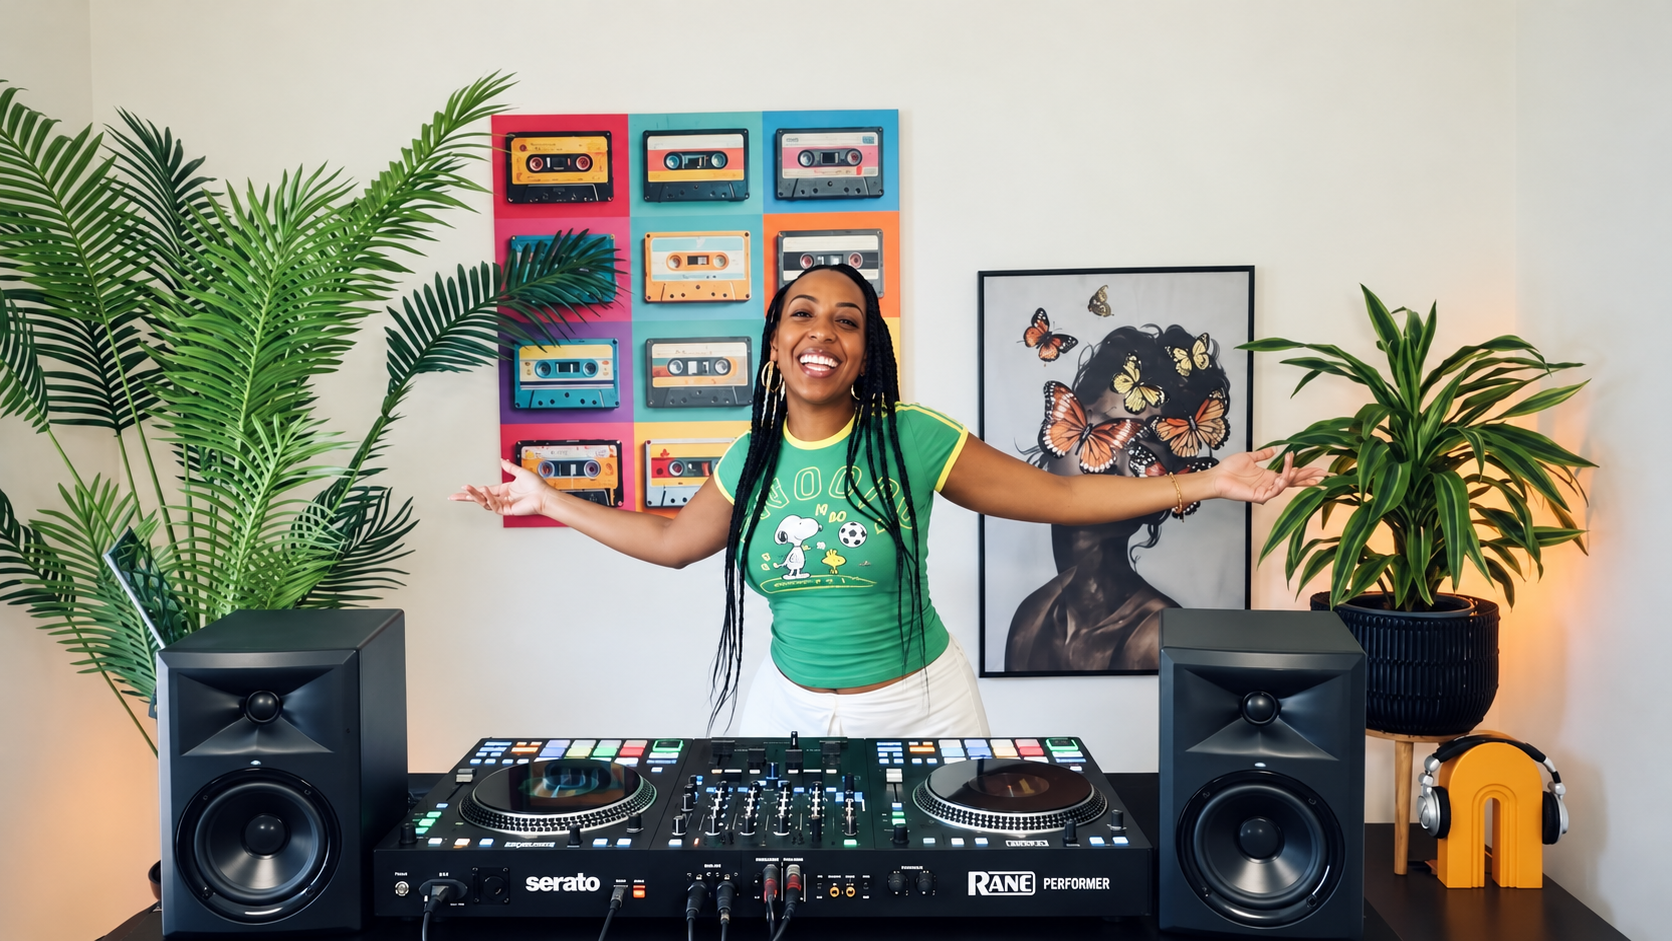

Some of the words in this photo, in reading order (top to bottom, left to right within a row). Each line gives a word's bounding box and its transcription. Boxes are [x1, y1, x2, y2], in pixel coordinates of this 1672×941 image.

[525, 873, 601, 892] serato
[968, 871, 1034, 896] RANE
[1043, 877, 1110, 890] PERFORMER
